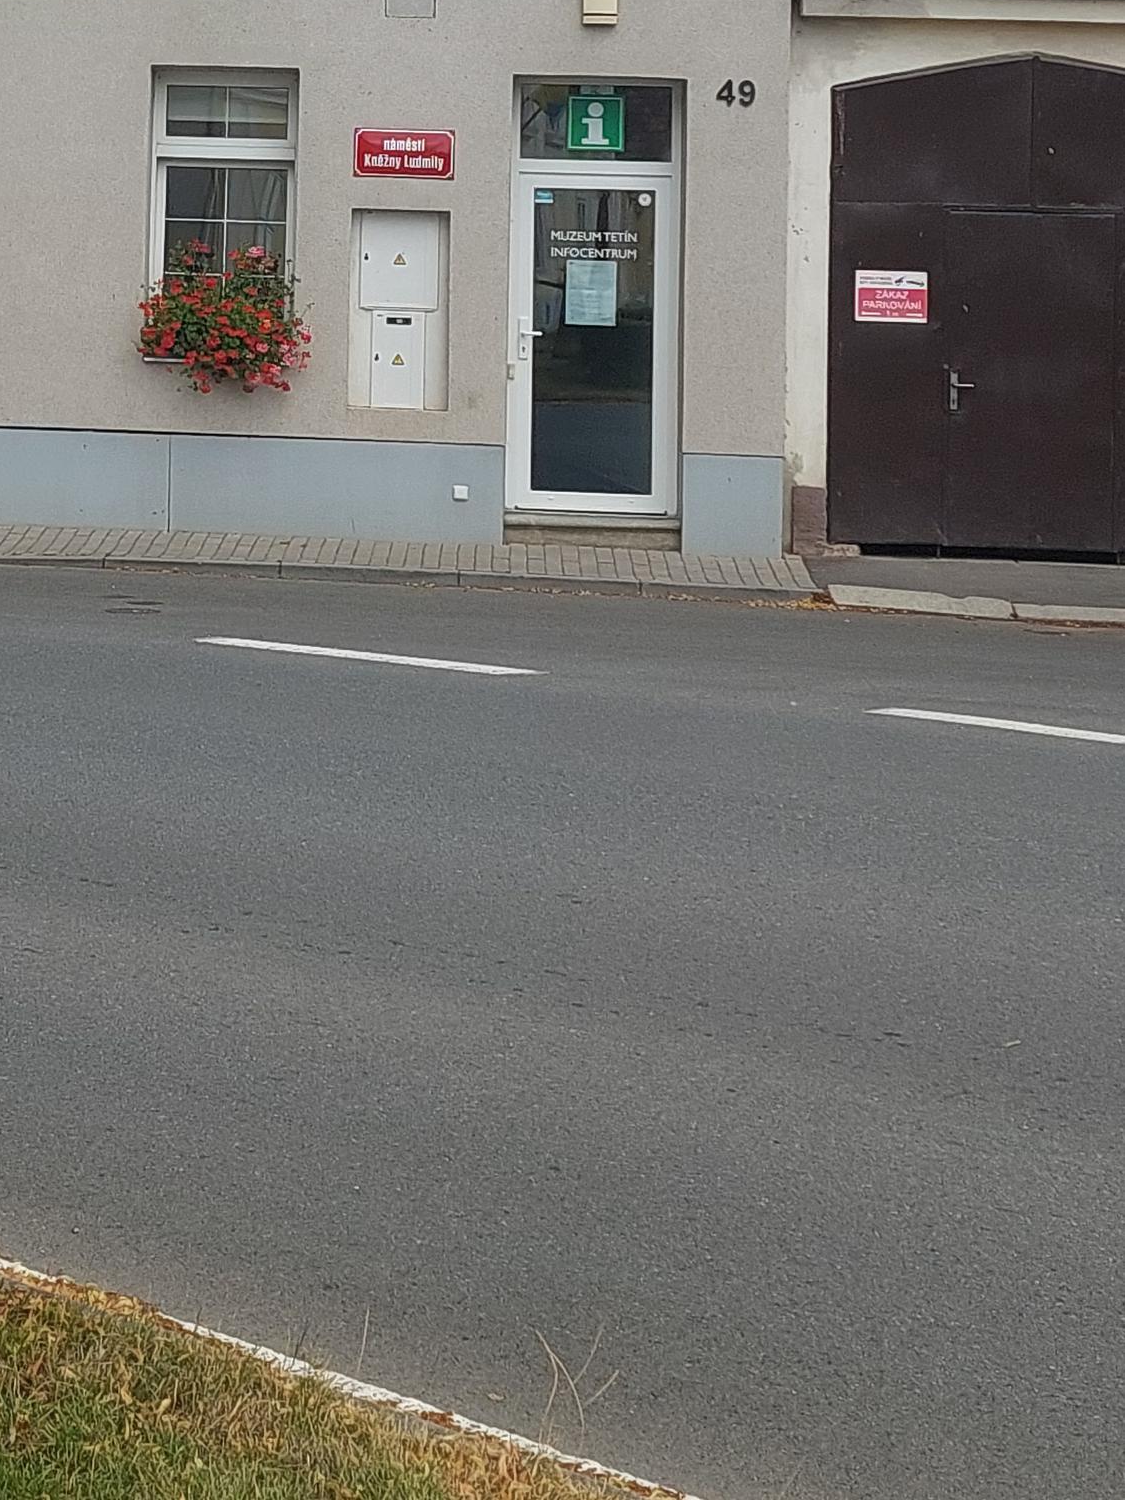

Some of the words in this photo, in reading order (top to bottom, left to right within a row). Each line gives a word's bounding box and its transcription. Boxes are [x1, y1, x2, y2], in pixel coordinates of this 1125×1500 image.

[715, 78, 756, 108] 49
[383, 136, 426, 152] náměstí
[363, 152, 402, 170] Kněžny
[403, 154, 445, 172] Ludmily
[550, 229, 602, 242] MUZEUM
[603, 229, 638, 243] TETÍN
[550, 246, 638, 261] INFOCENTRUM
